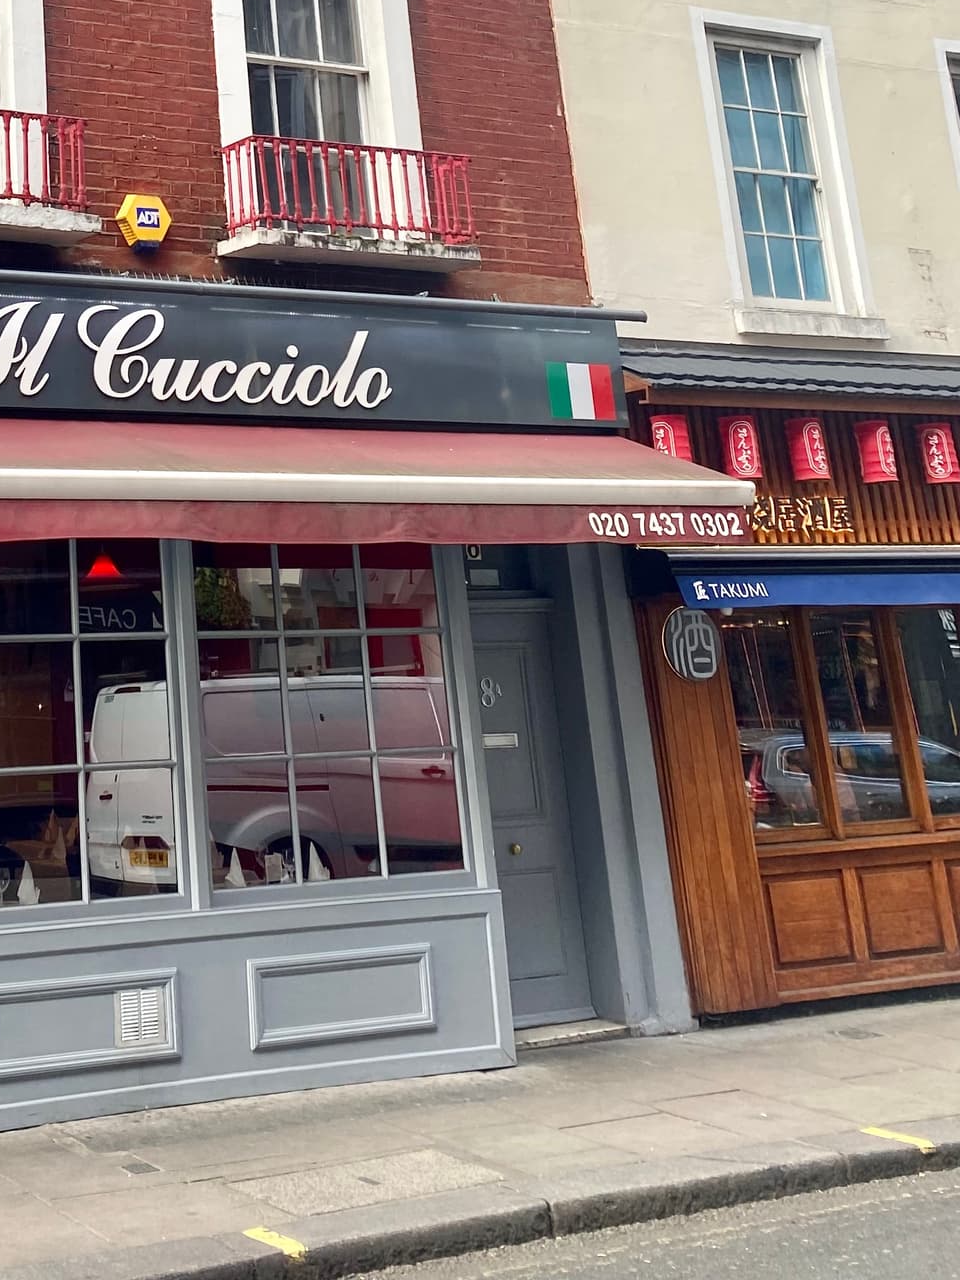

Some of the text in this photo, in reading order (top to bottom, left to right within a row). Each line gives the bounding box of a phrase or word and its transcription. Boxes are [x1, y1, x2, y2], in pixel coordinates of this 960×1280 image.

[137, 210, 160, 225] ADT
[77, 304, 393, 409] Cucciolo
[588, 512, 744, 537] 020 7437 0302
[708, 582, 769, 599] TAKUMI
